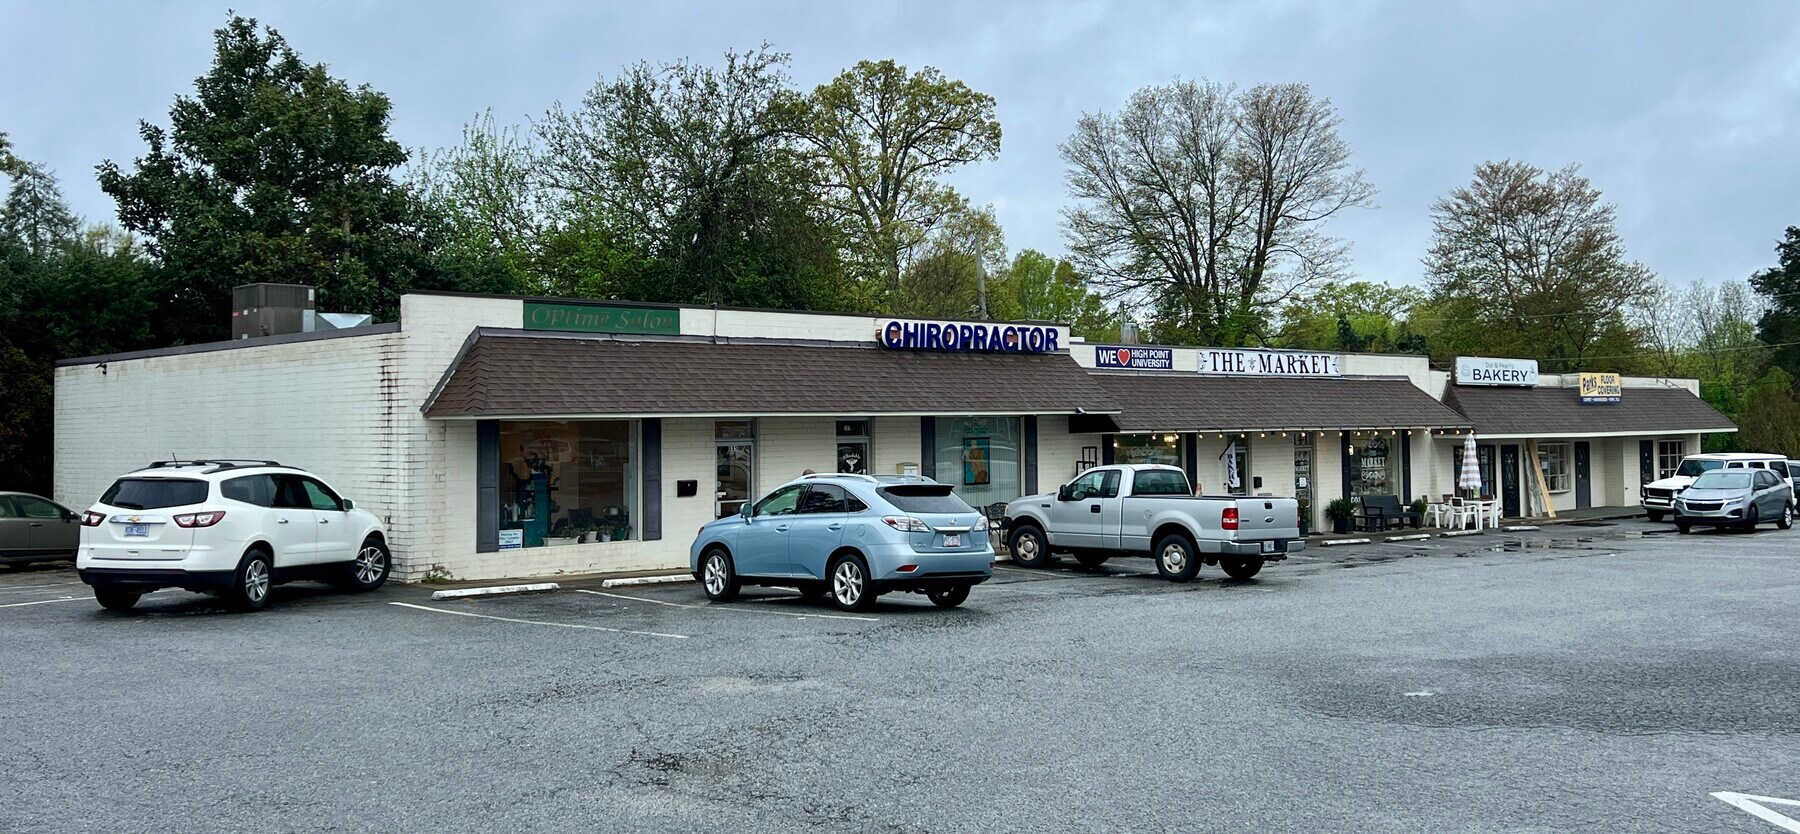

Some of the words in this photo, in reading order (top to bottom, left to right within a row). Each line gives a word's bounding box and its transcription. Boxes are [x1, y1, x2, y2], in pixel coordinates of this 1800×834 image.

[615, 309, 674, 329] Salon
[882, 320, 1059, 352] CHIROPRACTOR
[1098, 349, 1117, 365] WE
[1131, 348, 1148, 359] HIGH
[1149, 349, 1170, 360] POINT
[1131, 358, 1170, 369] UNIVERSITY
[1208, 351, 1246, 373] THE
[1258, 354, 1331, 374] MARKET
[1472, 368, 1529, 382] BAKERY
[1600, 374, 1616, 385] FLOOR
[1582, 374, 1598, 393] Parks
[1597, 385, 1620, 395] COVERING
[1361, 457, 1385, 468] MARKET
